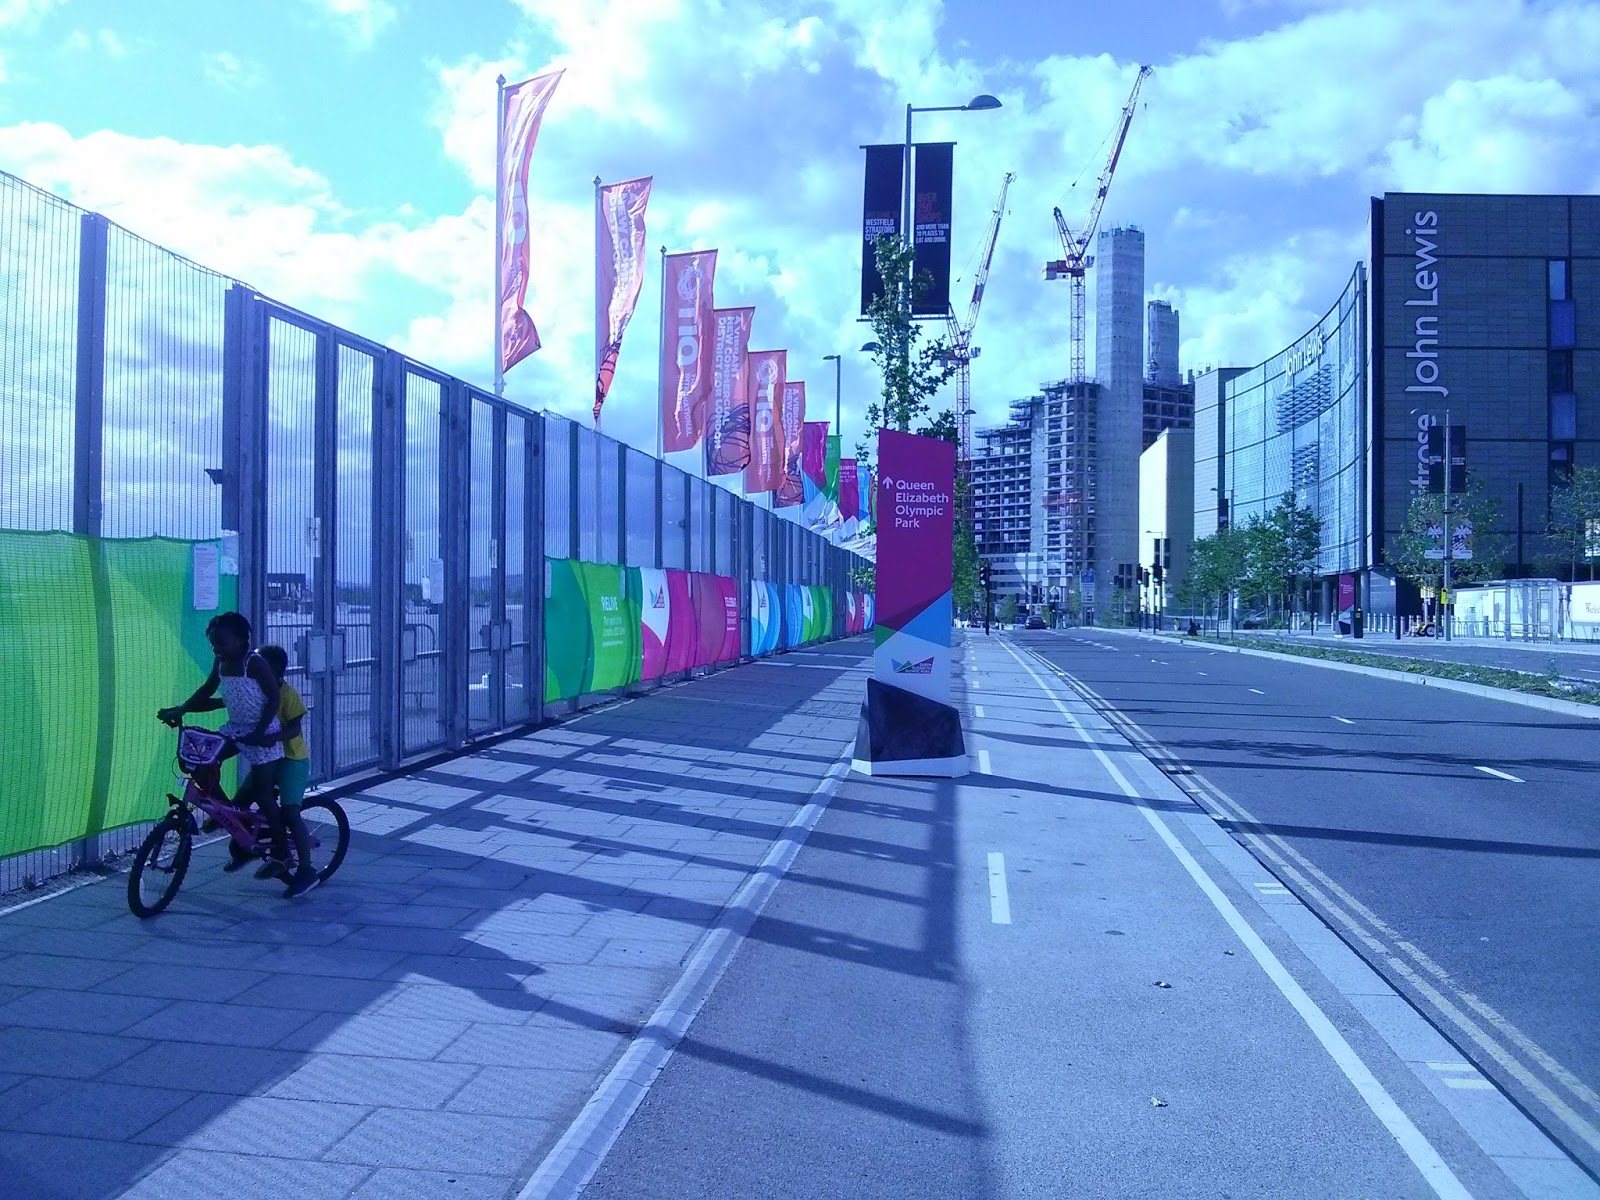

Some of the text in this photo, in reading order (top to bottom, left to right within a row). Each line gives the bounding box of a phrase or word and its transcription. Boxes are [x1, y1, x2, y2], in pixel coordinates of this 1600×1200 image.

[865, 218, 894, 226] WESTFIELD
[865, 226, 895, 234] STRATFORD
[1404, 210, 1449, 398] John Lewis
[725, 316, 735, 345] NEW
[734, 316, 742, 325] A
[715, 317, 727, 371] DISTRICT
[731, 327, 741, 380] VIBRANT
[1285, 346, 1303, 388] John
[714, 372, 723, 398] FOR
[722, 347, 733, 426] COMMERCIAL
[713, 399, 723, 450] LONDON
[896, 480, 934, 490] Queen
[896, 492, 949, 503] Elizabeth
[895, 505, 944, 518] Olympic
[895, 517, 920, 528] Park
